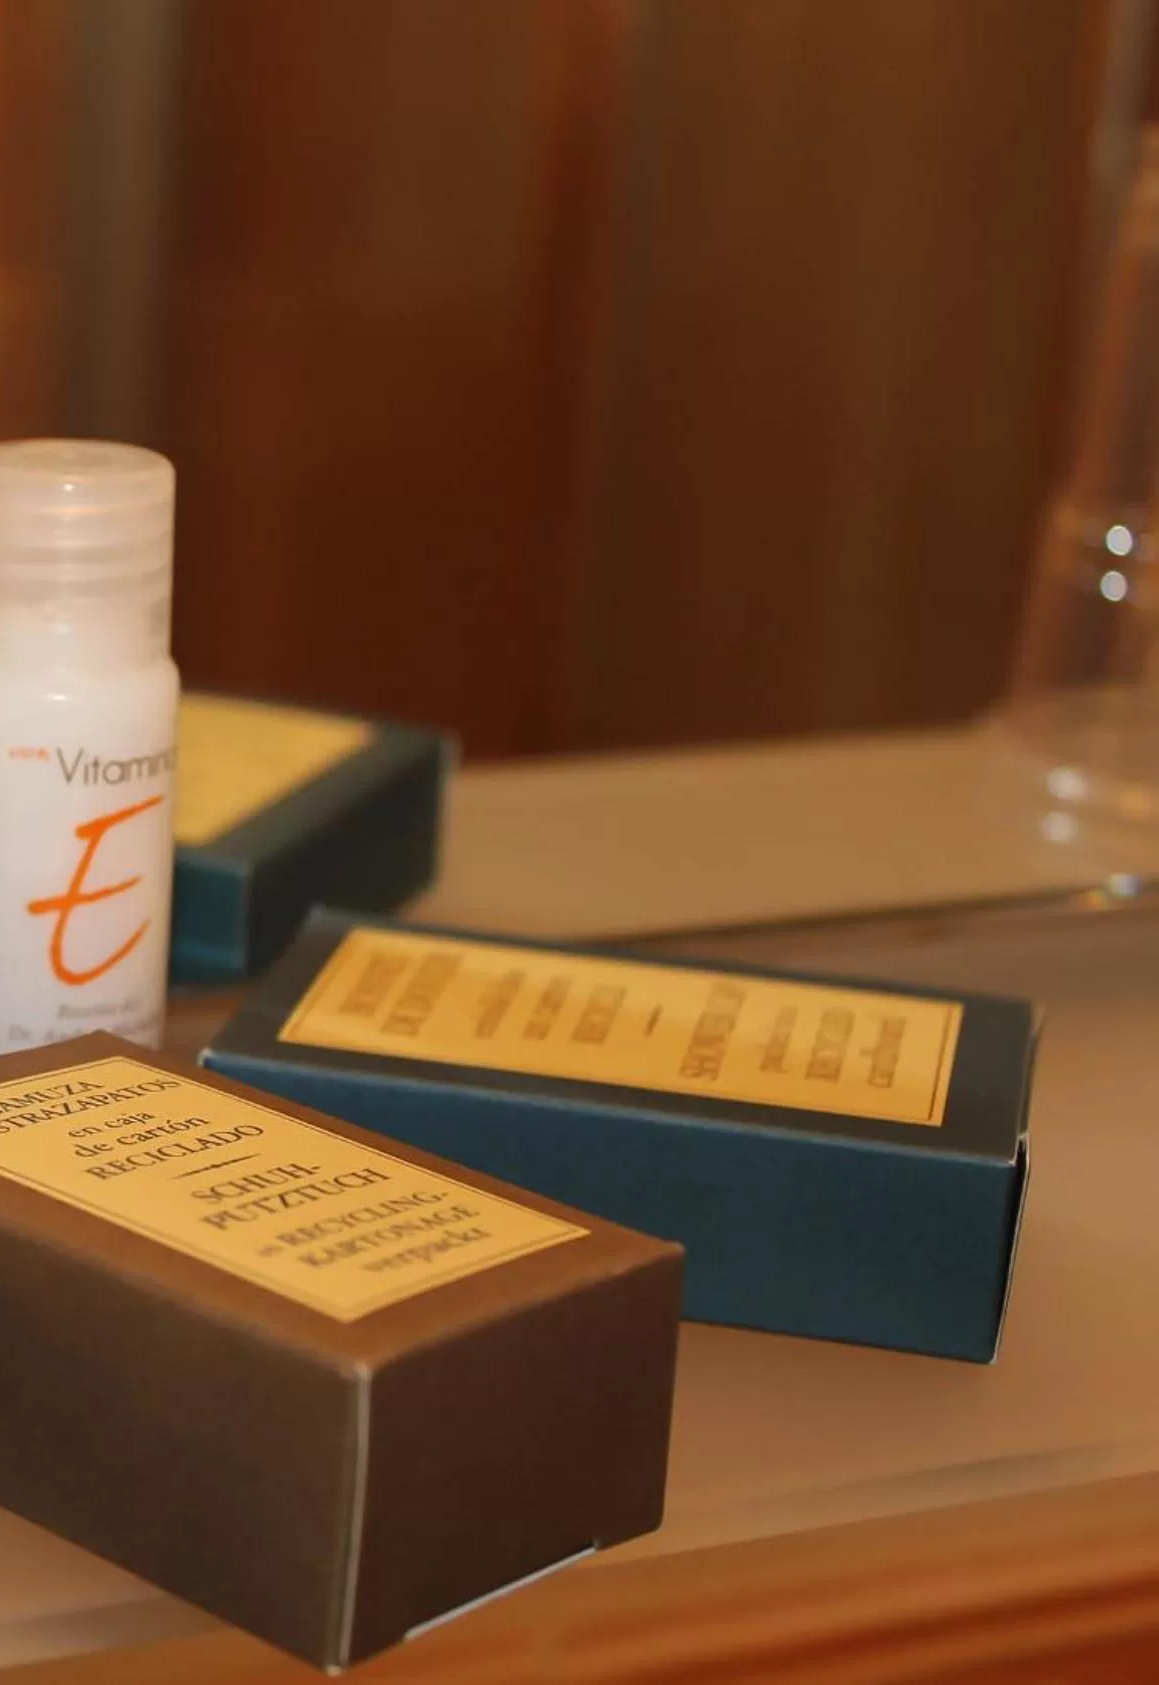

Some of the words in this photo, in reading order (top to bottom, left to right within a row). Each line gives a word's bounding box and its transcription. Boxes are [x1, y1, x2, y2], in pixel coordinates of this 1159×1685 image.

[56, 745, 177, 785] Vitamin
[27, 794, 163, 985] E
[67, 1124, 102, 1139] en
[104, 1109, 156, 1132] caja
[73, 1139, 114, 1159] de
[116, 1114, 211, 1148] cartón
[84, 1124, 265, 1181] RECICLADO
[190, 1162, 320, 1206] SCHUH-
[199, 1167, 391, 1232] PUTZTUCH
